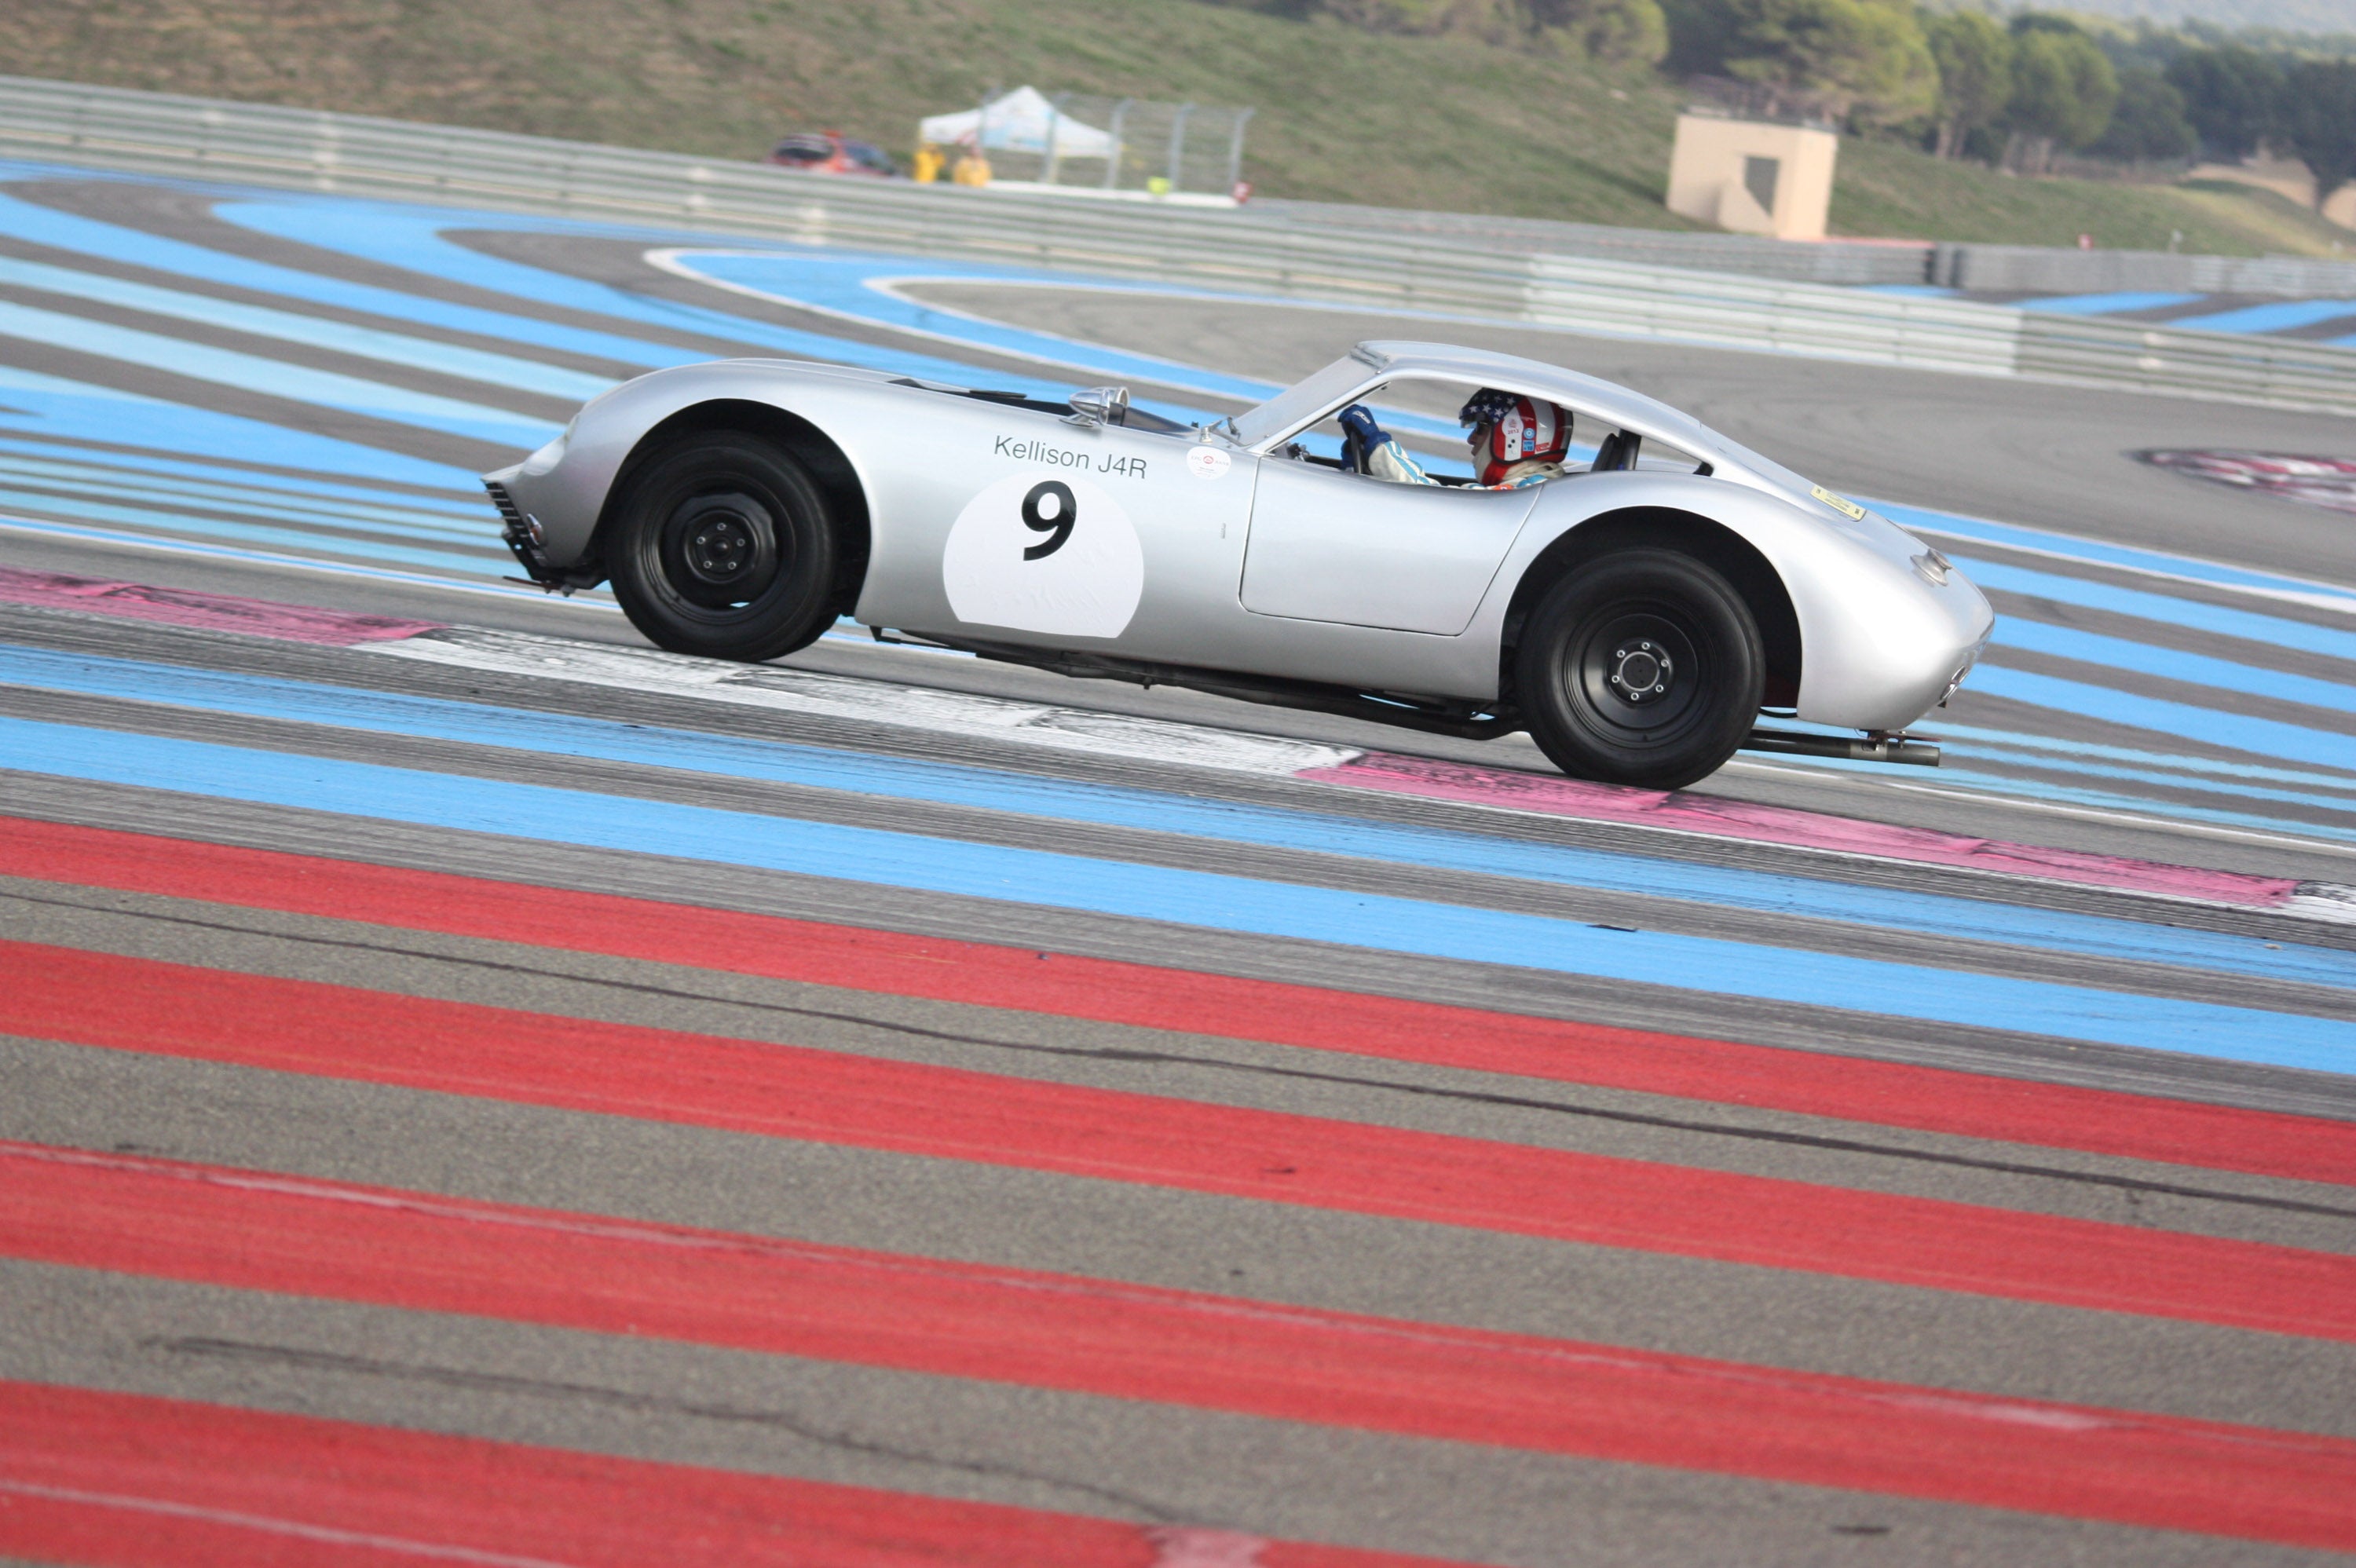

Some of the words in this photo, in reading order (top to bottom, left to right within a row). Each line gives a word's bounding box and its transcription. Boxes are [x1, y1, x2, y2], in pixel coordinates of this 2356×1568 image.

[994, 435, 1090, 470] Kellison
[1098, 454, 1147, 479] J4R
[1022, 480, 1077, 561] 9
